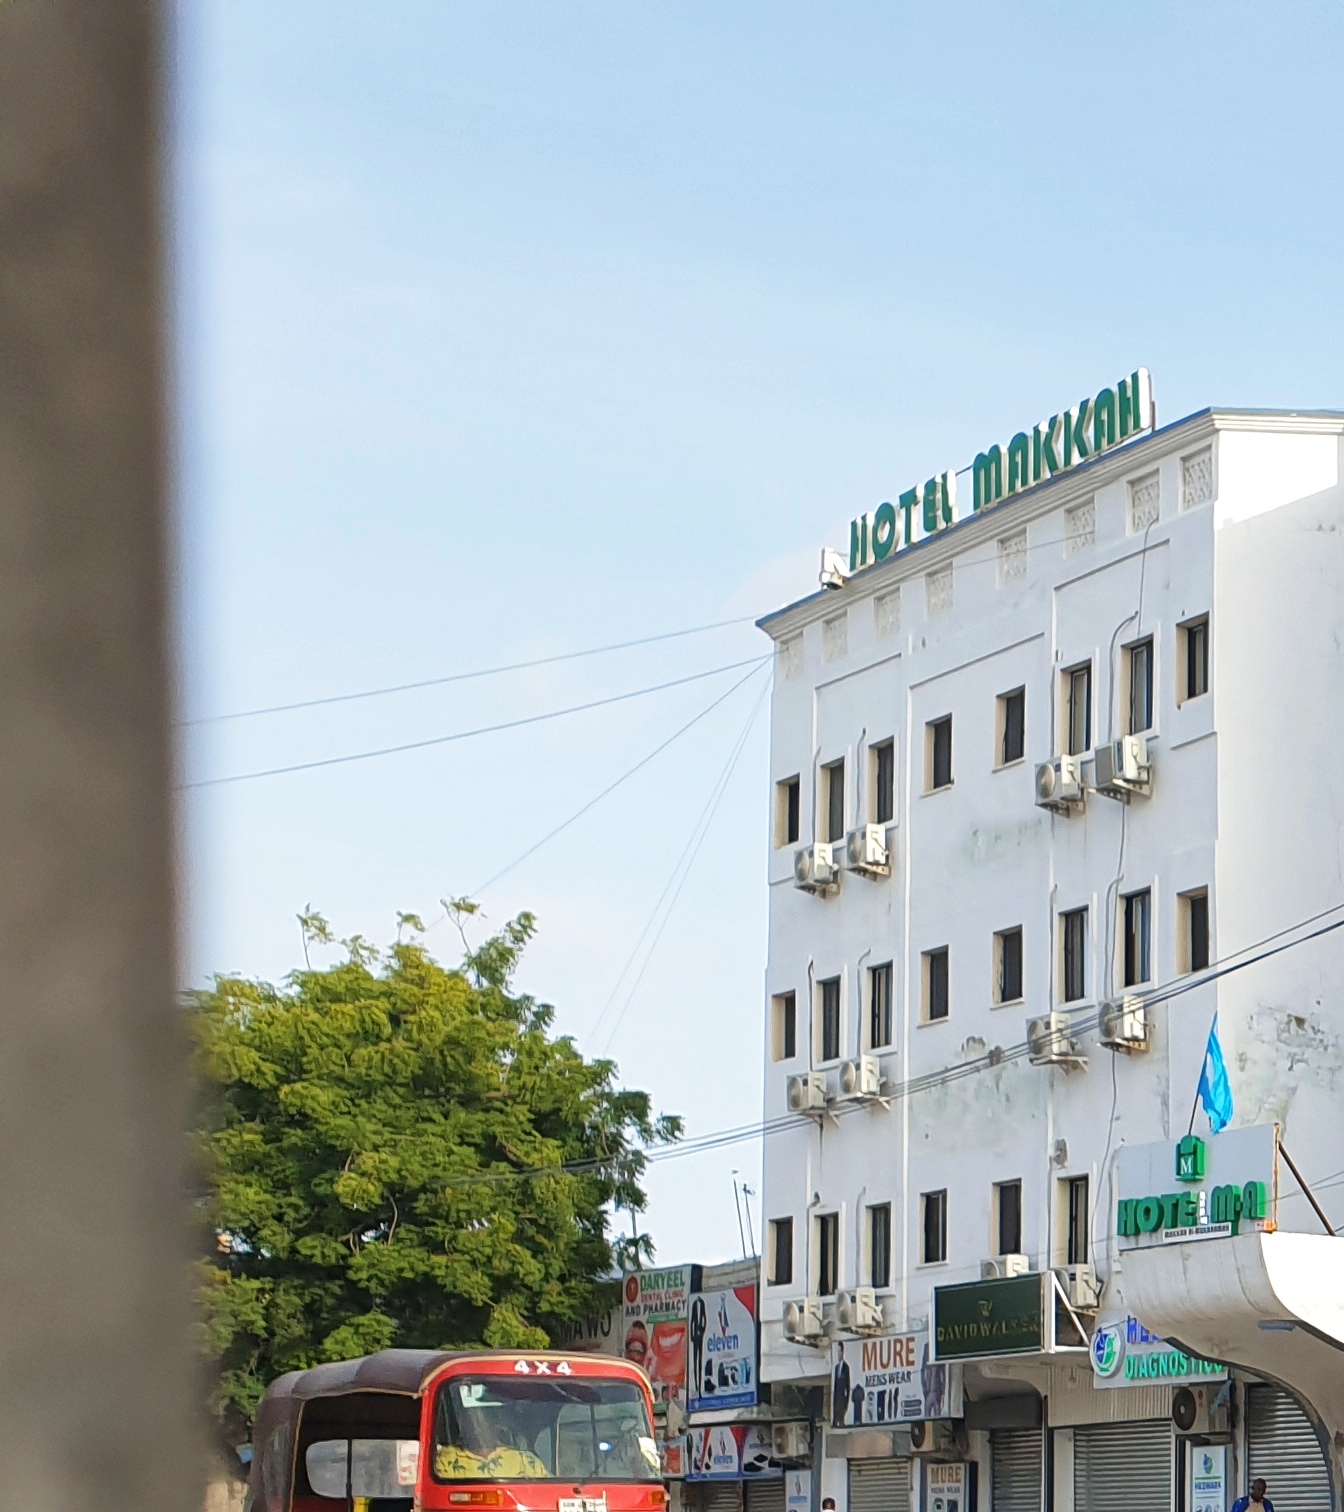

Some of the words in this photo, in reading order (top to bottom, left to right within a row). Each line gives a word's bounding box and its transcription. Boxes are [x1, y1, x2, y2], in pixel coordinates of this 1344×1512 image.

[849, 469, 959, 574] HOTEL
[972, 367, 1151, 513] MAKKAH
[1117, 1190, 1209, 1237] HOTEL
[640, 1270, 686, 1291] DARYEEL
[625, 1305, 641, 1318] AND
[643, 1299, 687, 1316] PHARMACY
[707, 1332, 739, 1352] eleven
[937, 1323, 978, 1342] DAVID
[862, 1336, 916, 1373] MURE
[888, 1370, 912, 1385] WEAR
[930, 1466, 962, 1485] MURE
